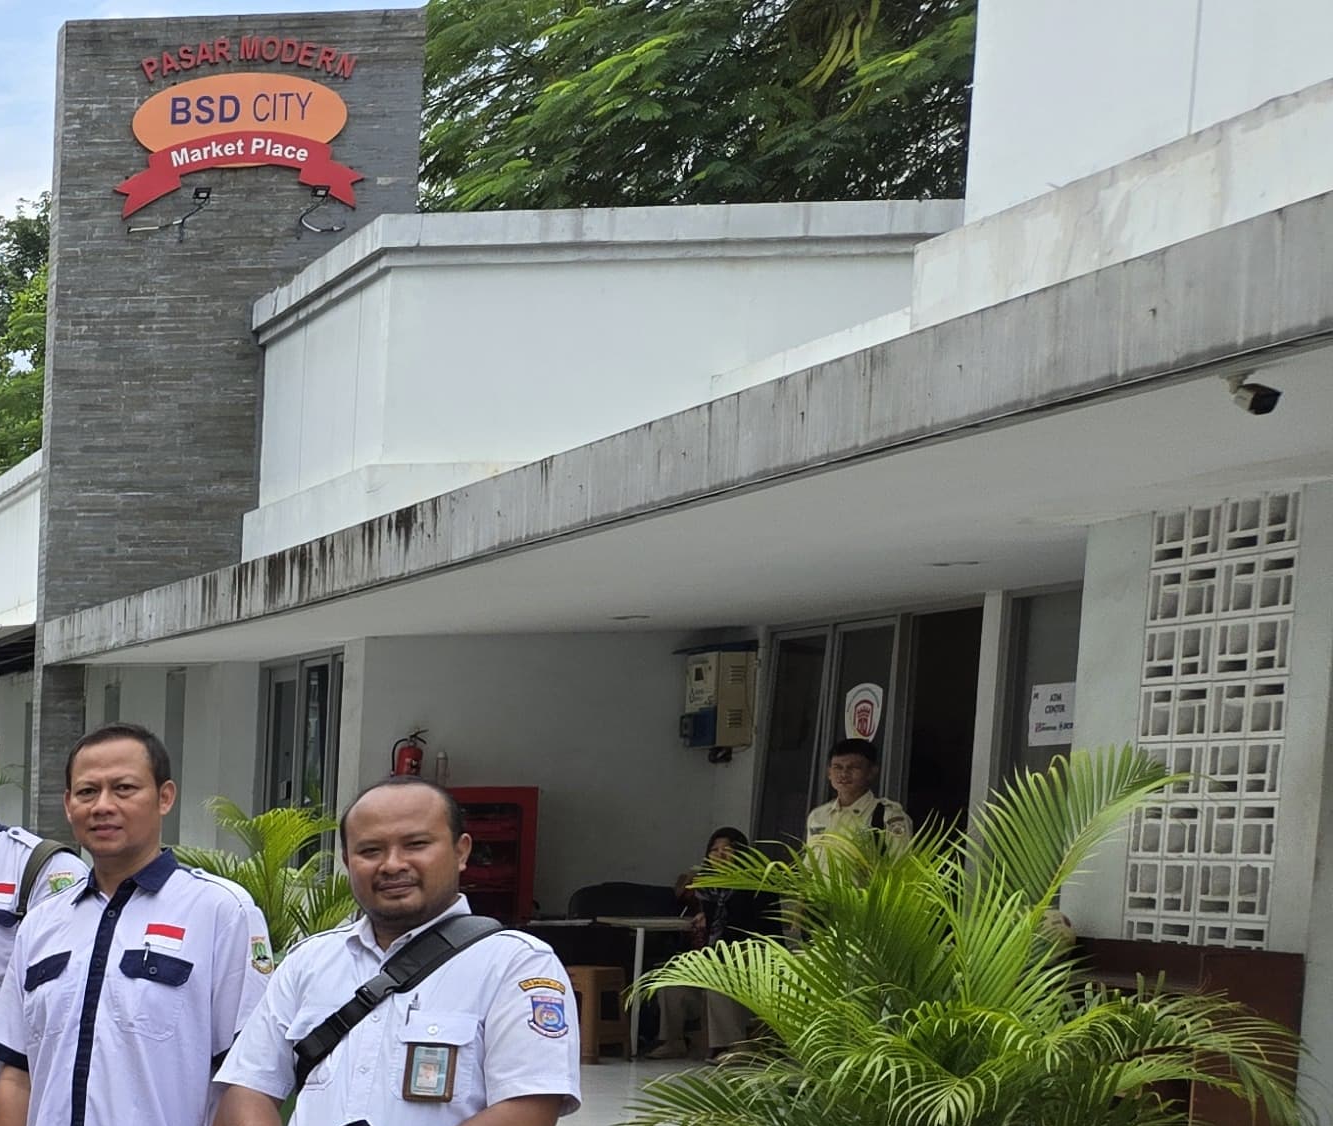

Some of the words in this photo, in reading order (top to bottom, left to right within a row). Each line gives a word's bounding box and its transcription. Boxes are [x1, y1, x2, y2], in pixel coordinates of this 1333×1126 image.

[140, 38, 231, 83] PASAR
[239, 35, 358, 80] MODERN
[170, 95, 240, 126] BSD
[253, 91, 314, 122] CITY
[170, 140, 244, 168] Market
[250, 138, 309, 163] Place
